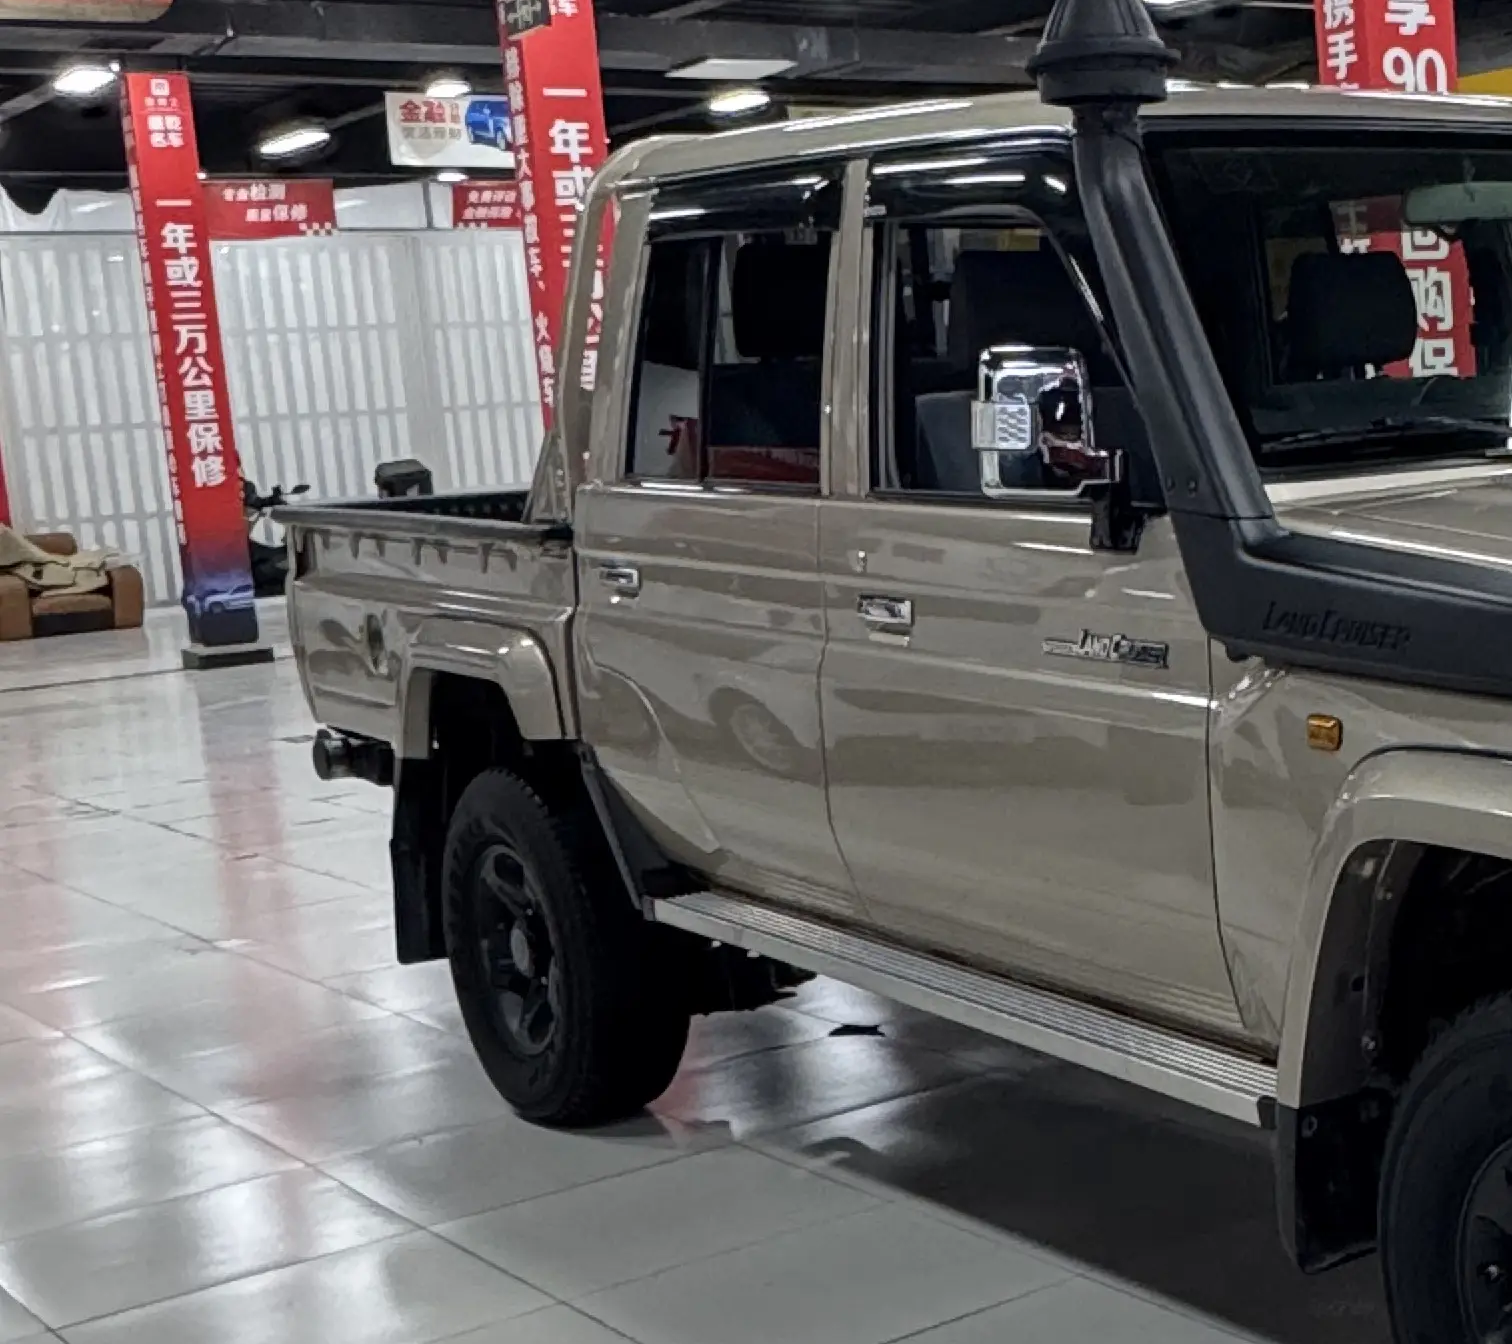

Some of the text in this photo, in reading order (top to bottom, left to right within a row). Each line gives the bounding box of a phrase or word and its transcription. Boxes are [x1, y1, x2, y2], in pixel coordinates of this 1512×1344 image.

[155, 197, 227, 489] 一年或三万公里保修
